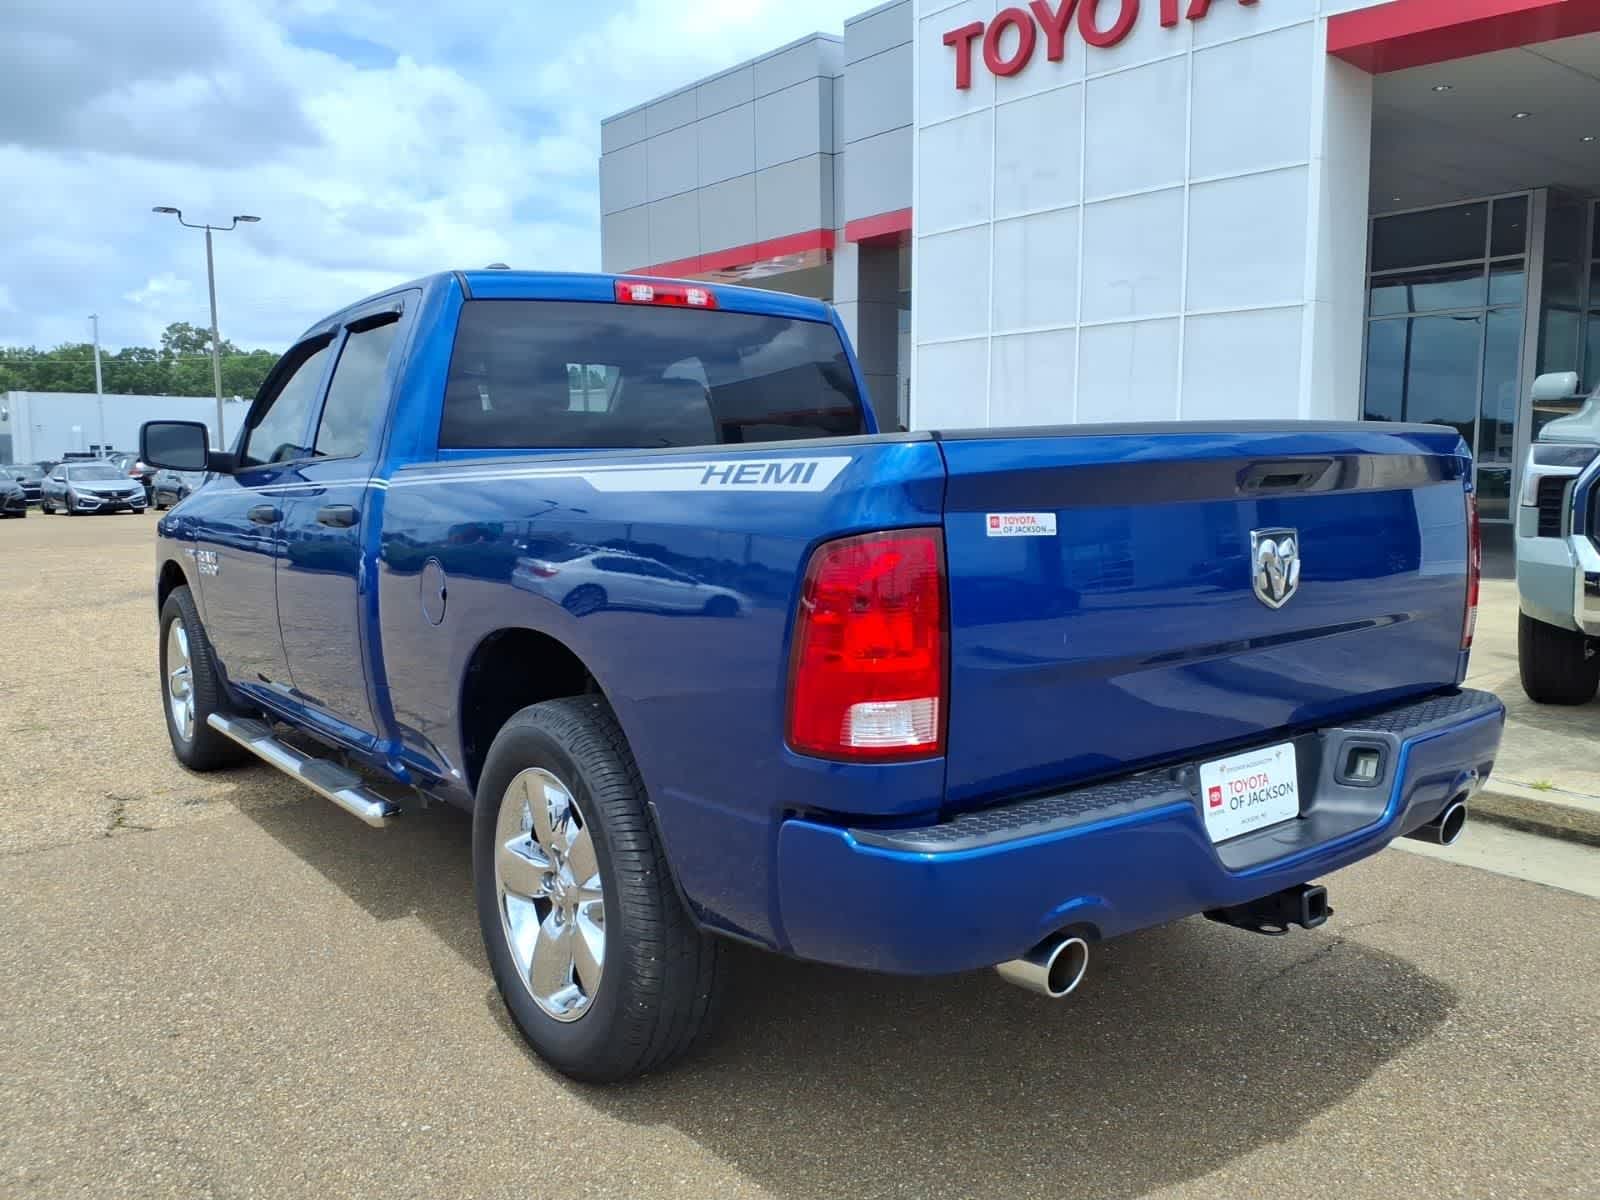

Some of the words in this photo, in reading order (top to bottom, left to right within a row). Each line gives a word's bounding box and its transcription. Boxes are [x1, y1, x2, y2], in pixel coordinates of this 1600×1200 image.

[943, 0, 1258, 90] TOYO
[700, 462, 819, 485] HEMI
[1003, 516, 1036, 525] TOYOTA
[1003, 526, 1013, 534] OF
[1015, 525, 1047, 534] JACKSON
[1229, 773, 1269, 795] TOYOTA
[1230, 795, 1245, 810] OF
[1247, 781, 1294, 806] JACKSON
